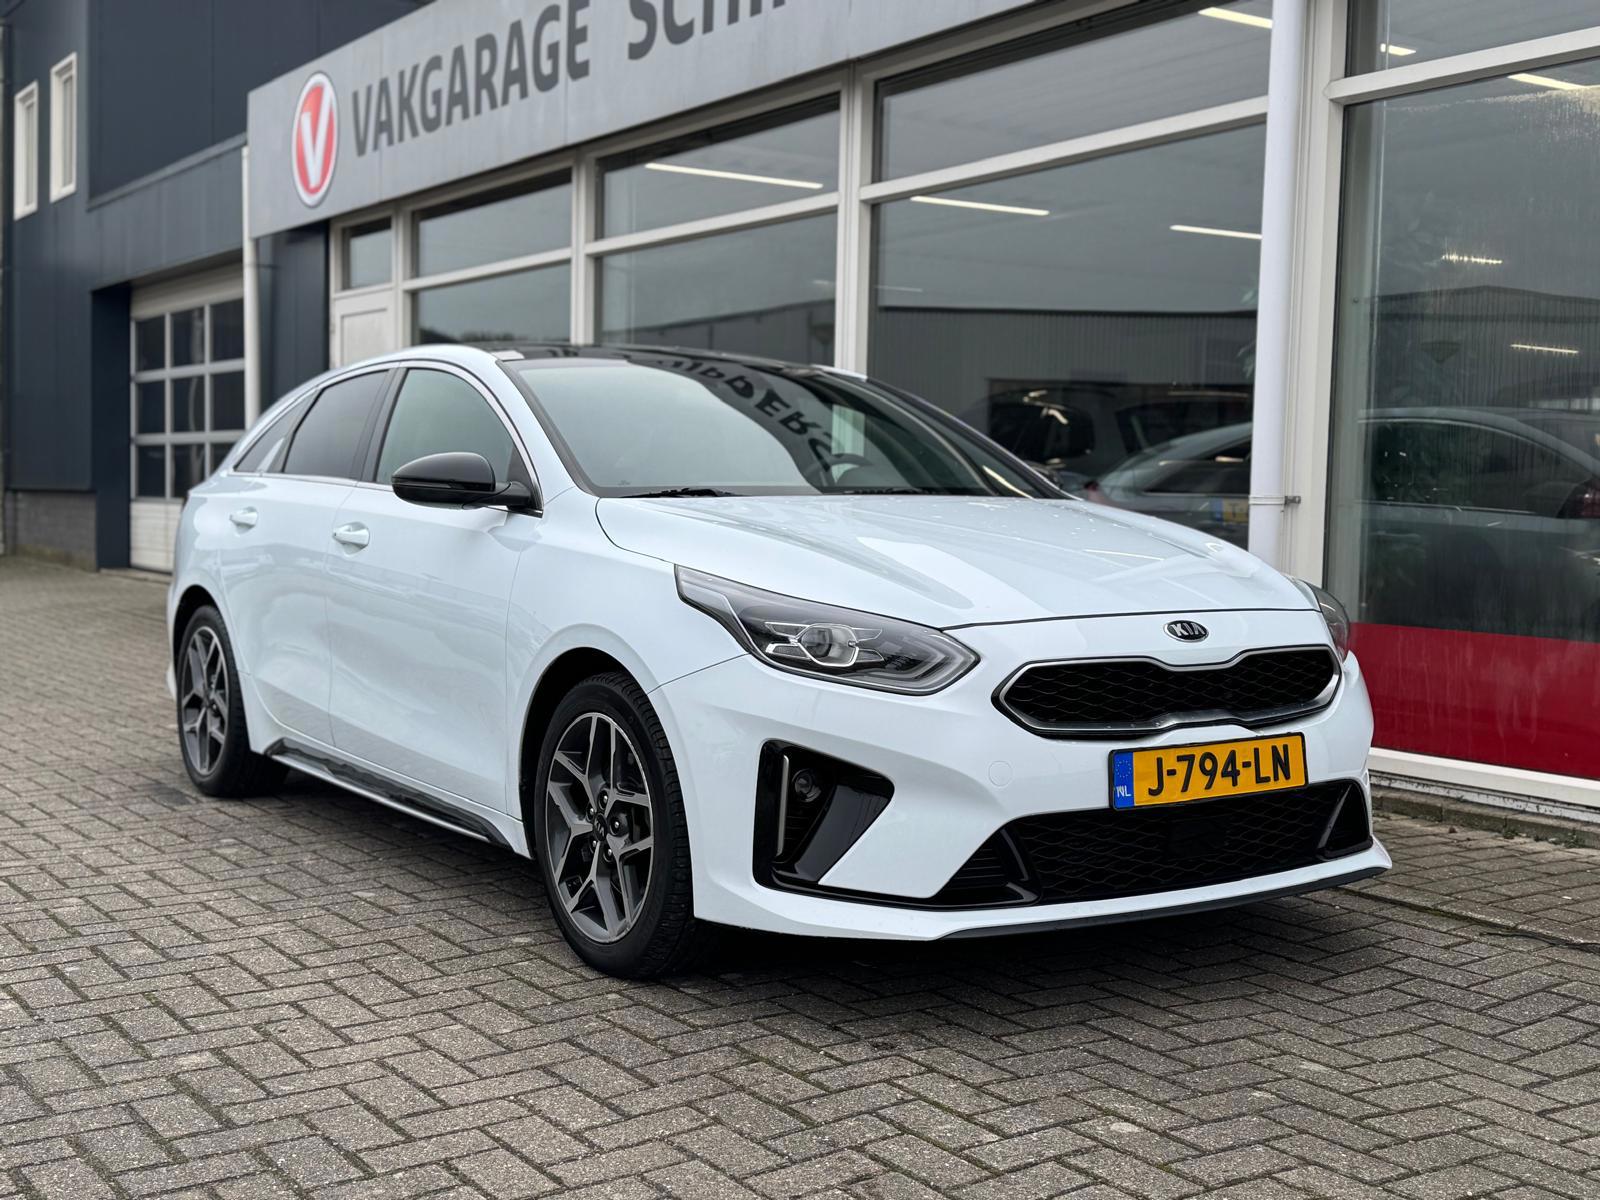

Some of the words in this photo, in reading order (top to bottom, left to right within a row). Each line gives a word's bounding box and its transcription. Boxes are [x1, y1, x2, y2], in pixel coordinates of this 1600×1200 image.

[352, 0, 590, 158] VAKGARAGE
[1169, 622, 1206, 637] KIA
[1148, 744, 1291, 796] J-794-LN
[1116, 785, 1131, 797] NL
